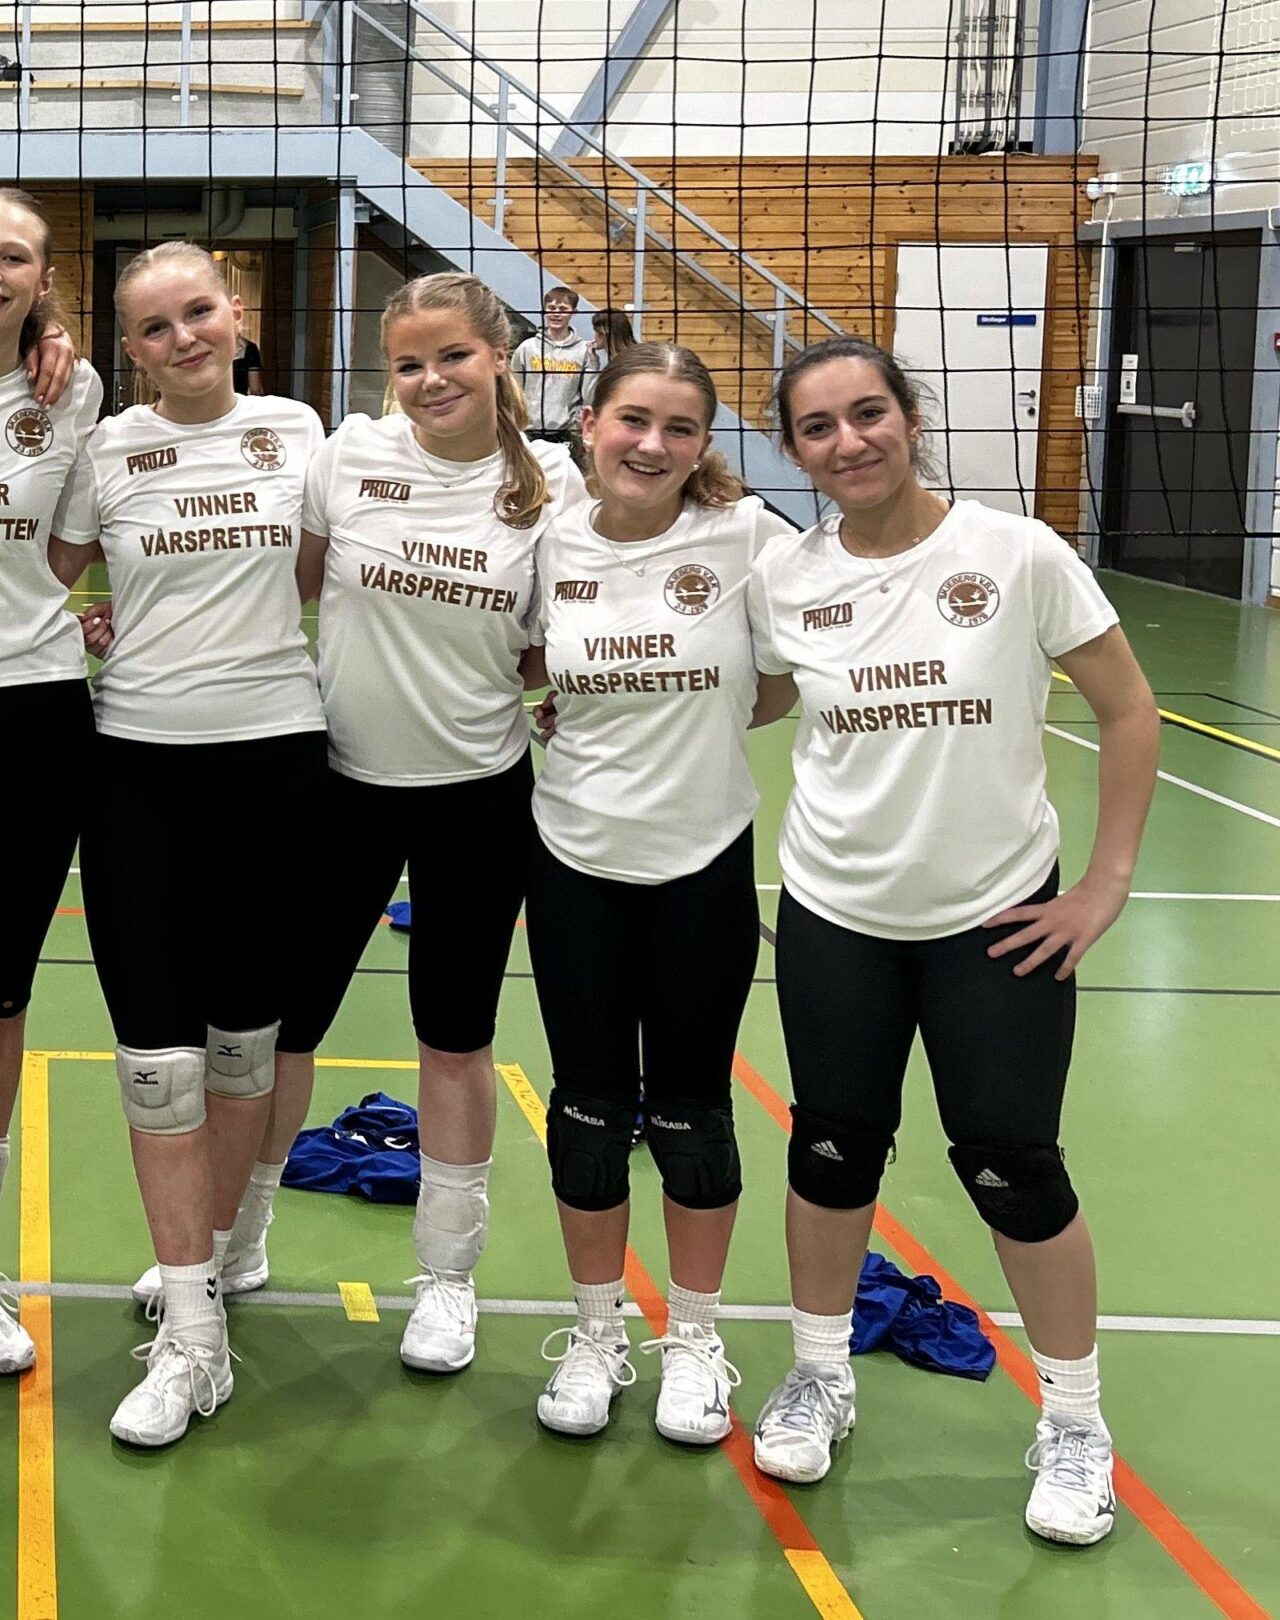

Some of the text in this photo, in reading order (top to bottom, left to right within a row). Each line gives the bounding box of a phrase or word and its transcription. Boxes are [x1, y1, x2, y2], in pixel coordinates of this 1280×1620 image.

[174, 491, 258, 518] VINNER
[140, 523, 292, 557] VÅRSPRETTEN
[402, 540, 488, 574] VINNER
[360, 562, 518, 614] VÅRSPRETTEN
[584, 633, 677, 662] VINNER
[552, 665, 720, 697] VÅRSPRETTEN
[848, 659, 948, 693] VINNER
[820, 698, 992, 735] VÅRSPRETTEN
